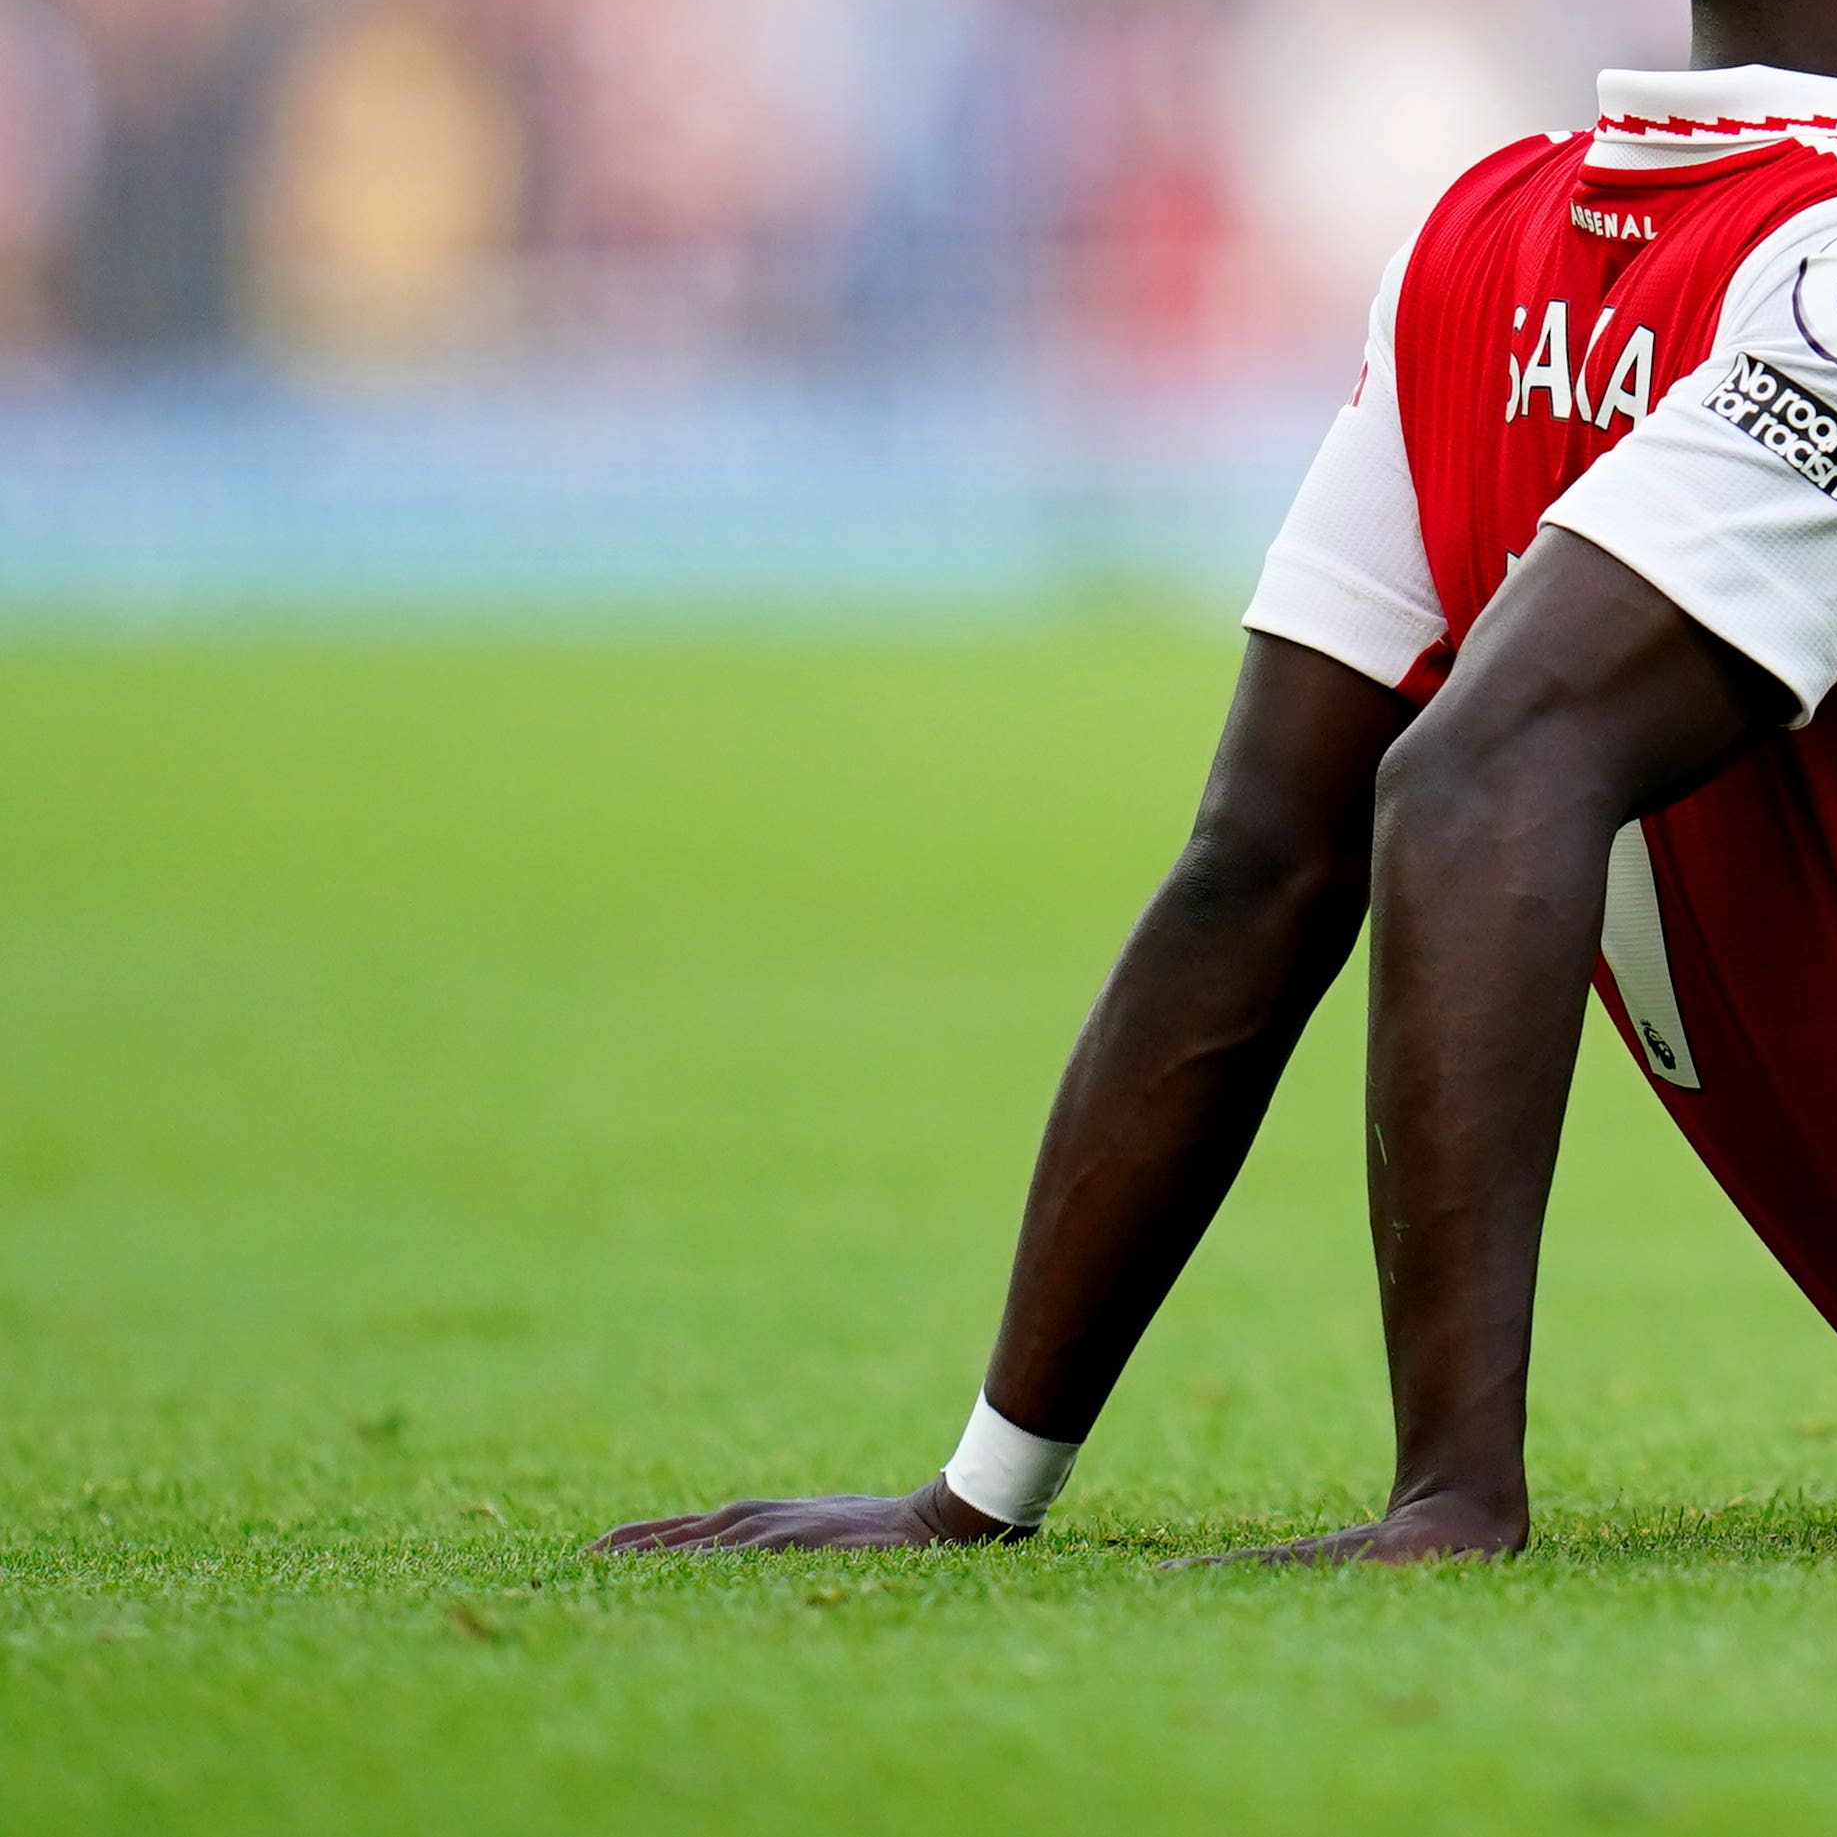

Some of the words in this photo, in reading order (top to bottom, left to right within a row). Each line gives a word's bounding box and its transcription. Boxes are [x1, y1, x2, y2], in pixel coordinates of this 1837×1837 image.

[1569, 199, 1660, 241] ARSENAL
[1729, 352, 1778, 402] No
[1703, 380, 1760, 425] for
